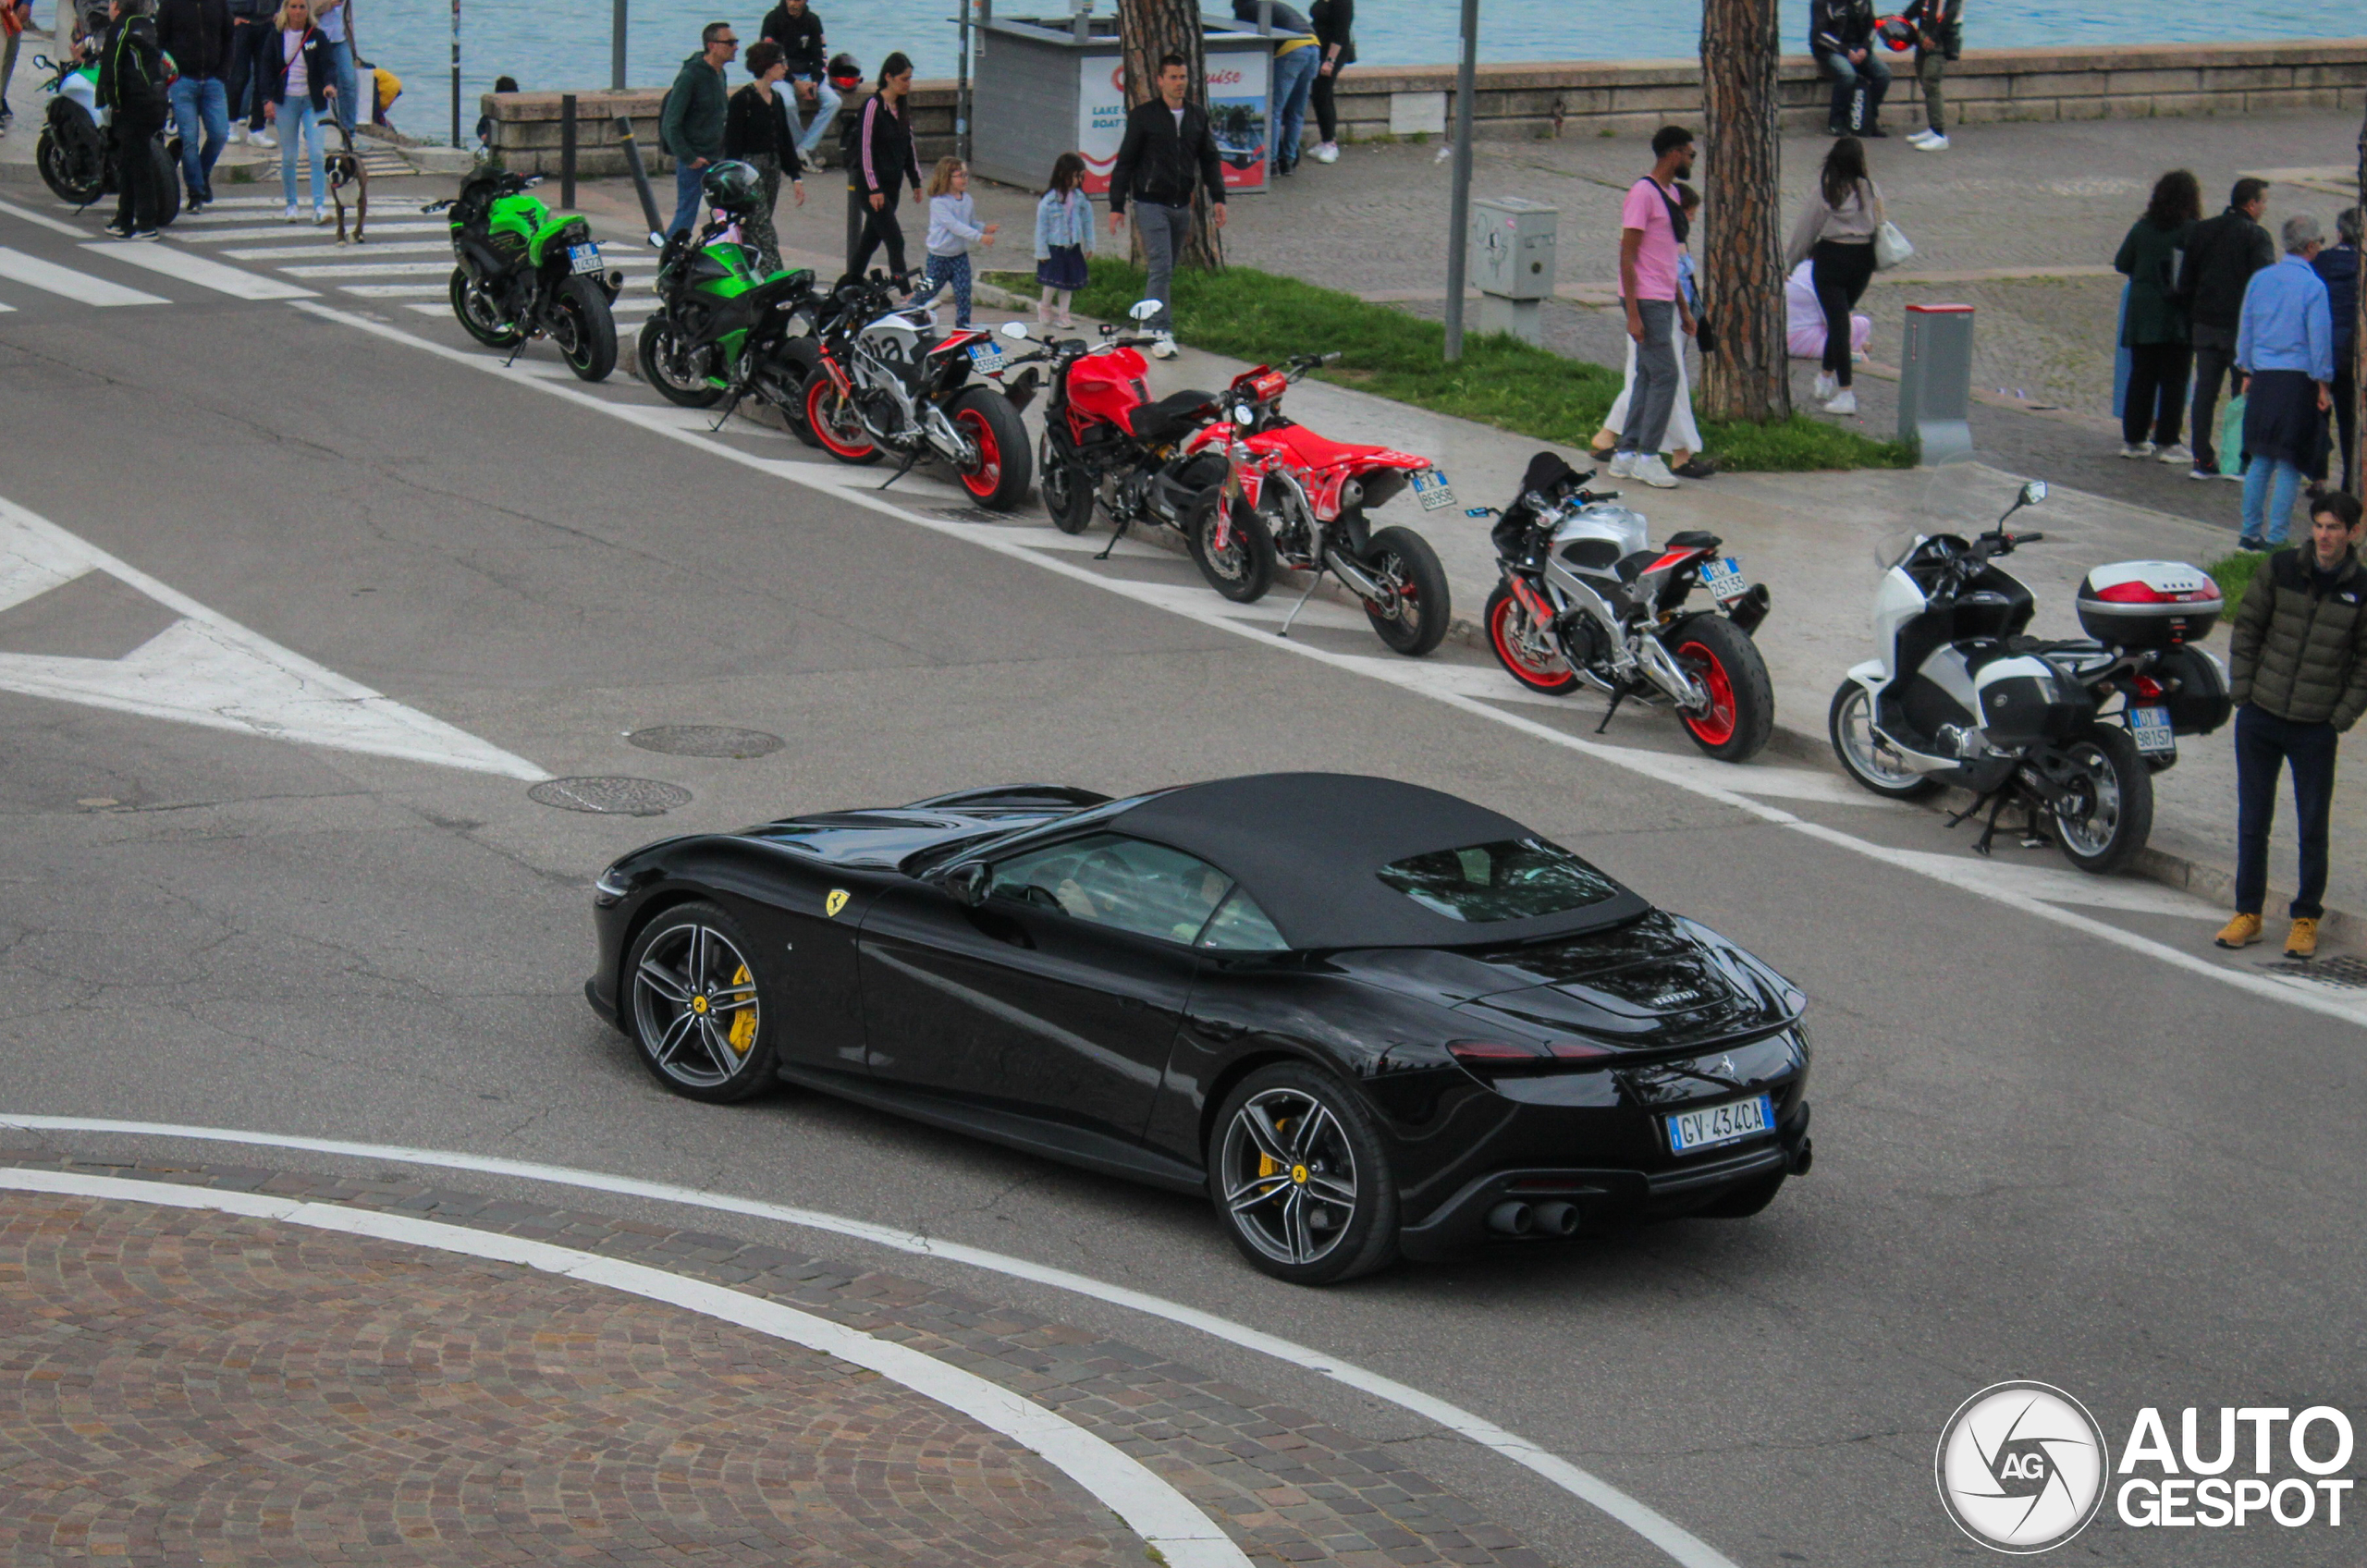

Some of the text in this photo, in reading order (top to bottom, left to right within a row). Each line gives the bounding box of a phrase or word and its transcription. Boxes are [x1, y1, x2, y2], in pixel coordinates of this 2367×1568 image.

[1092, 105, 1120, 116] LAKE
[1850, 89, 1864, 130] adidas
[1092, 119, 1120, 129] BOAT
[1422, 488, 1453, 507] 86958
[1708, 563, 1725, 579] EC
[1711, 575, 1746, 597] 25133
[2140, 709, 2155, 728] DY
[2137, 729, 2170, 747] 98157
[1683, 1113, 1704, 1145] GV
[1712, 1100, 1763, 1137] 434CA
